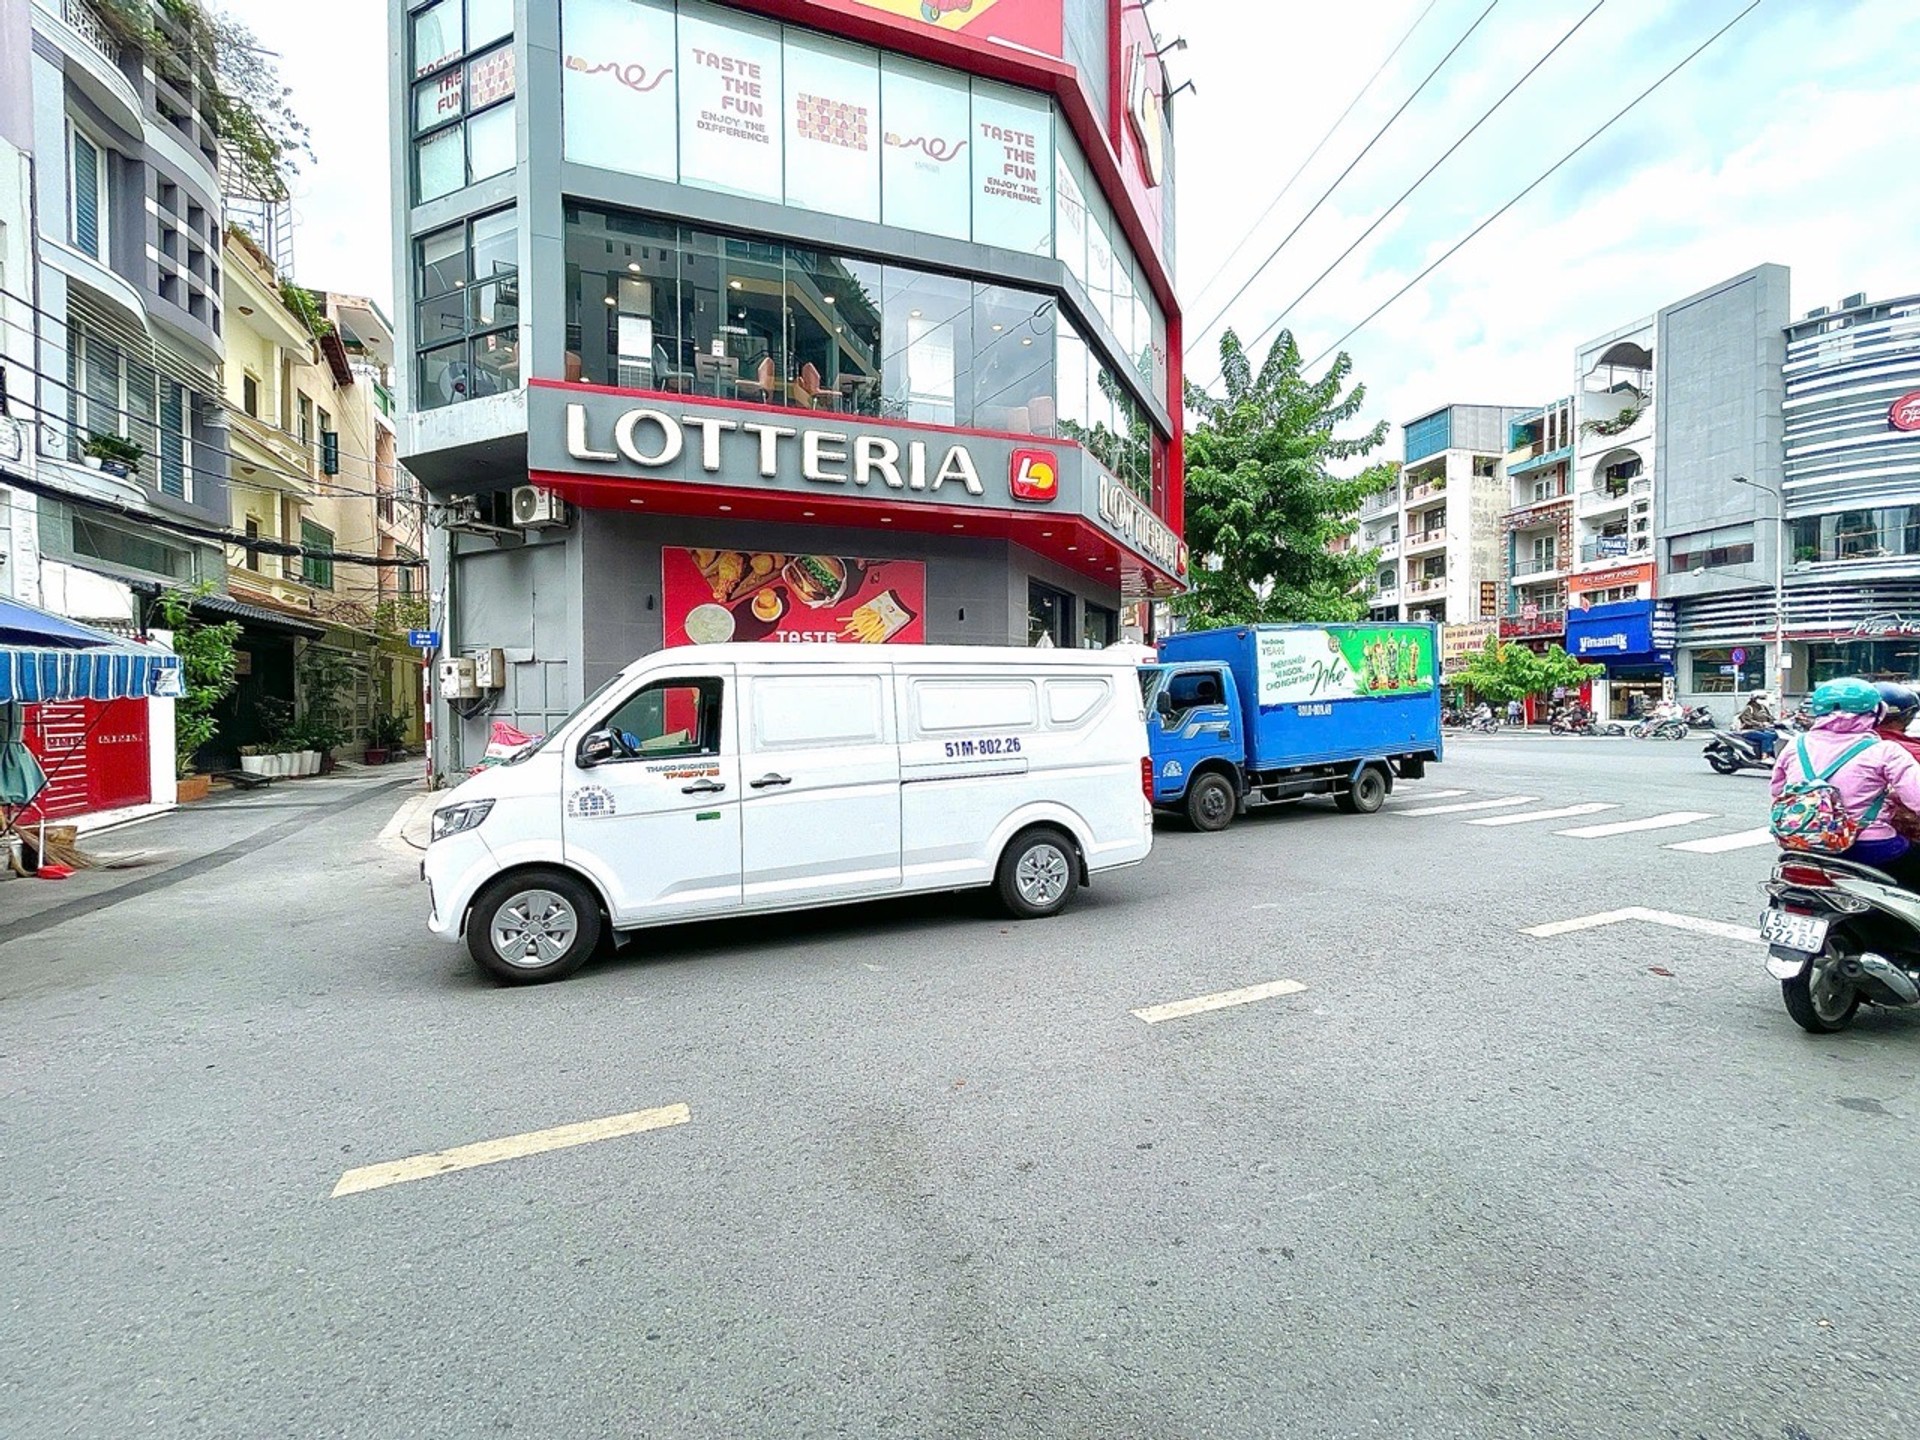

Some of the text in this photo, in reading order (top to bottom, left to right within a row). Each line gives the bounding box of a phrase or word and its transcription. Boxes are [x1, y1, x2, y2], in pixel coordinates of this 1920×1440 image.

[692, 48, 761, 79] TASTE
[721, 75, 762, 99] THE
[721, 95, 763, 118] FUN
[697, 120, 769, 144] DIFFERENCE
[701, 110, 766, 133] ENJOY THE
[980, 123, 1035, 148] TASTE
[1003, 146, 1035, 165] THE
[1003, 163, 1036, 182] FUN
[983, 185, 1042, 205] DIFFERENCE
[987, 177, 1038, 195] ENJOY THE
[565, 403, 984, 496] LOTTERIA
[776, 631, 837, 643] TASTE
[1579, 633, 1628, 653] Vinamilk
[945, 737, 1021, 757] 51M-802.26
